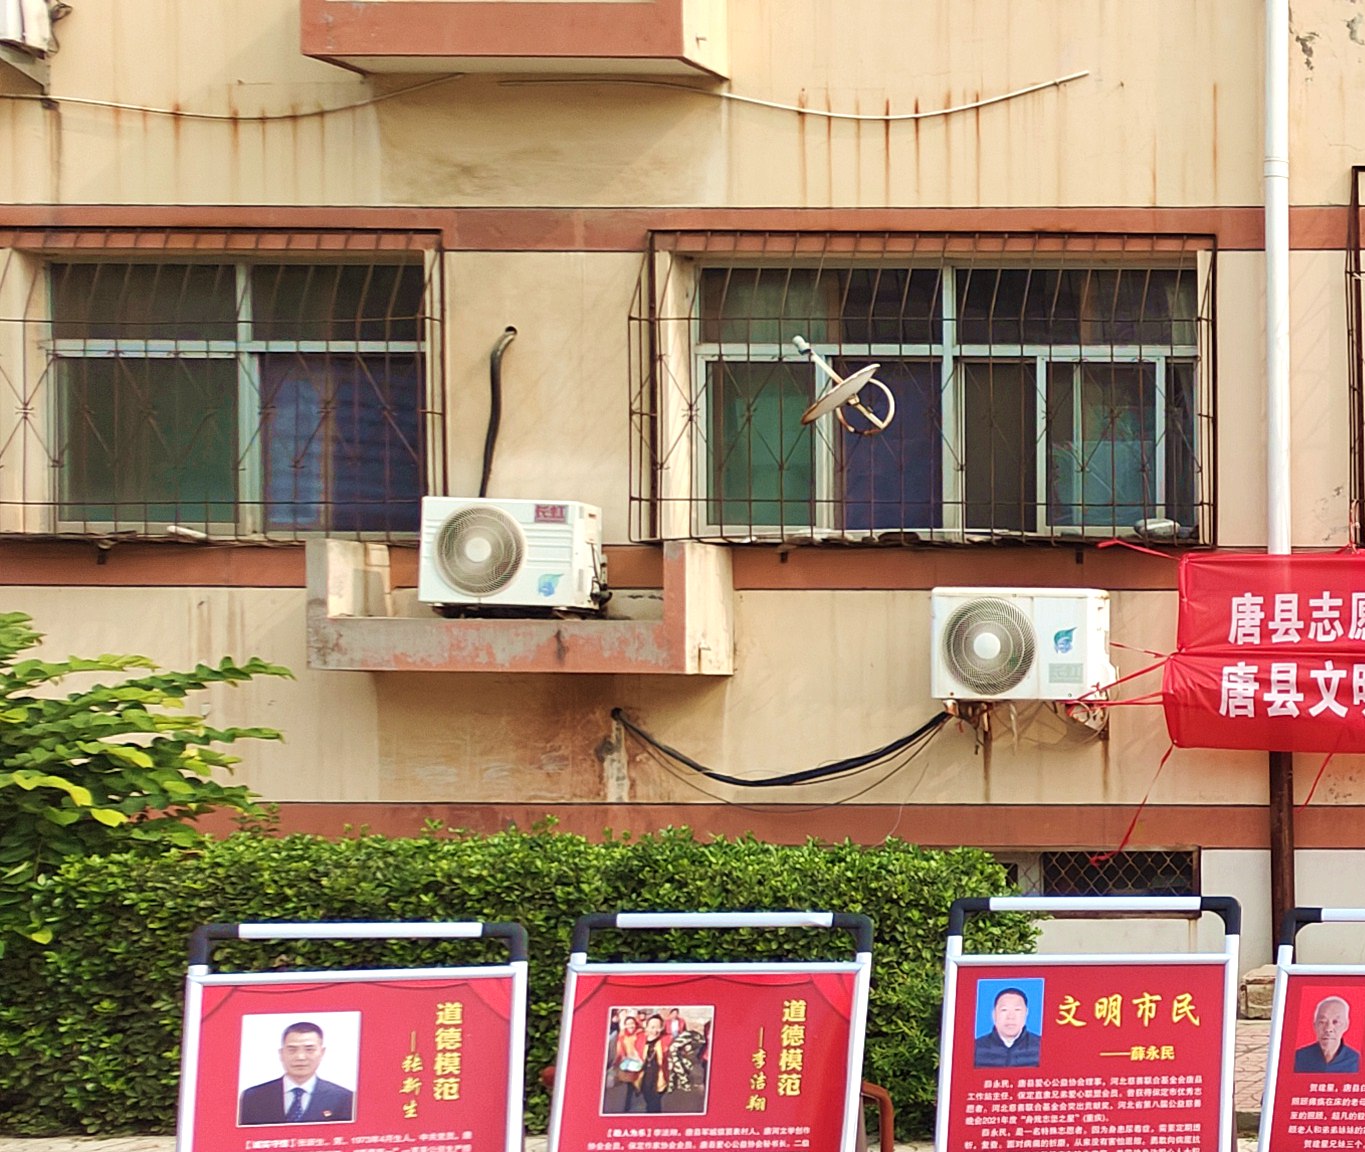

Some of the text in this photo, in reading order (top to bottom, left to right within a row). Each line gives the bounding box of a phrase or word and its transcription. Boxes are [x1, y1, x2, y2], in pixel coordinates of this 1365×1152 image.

[433, 1002, 464, 1102] 道德模范
[777, 999, 807, 1097] 道德模范
[1055, 992, 1200, 1027] 文明市民
